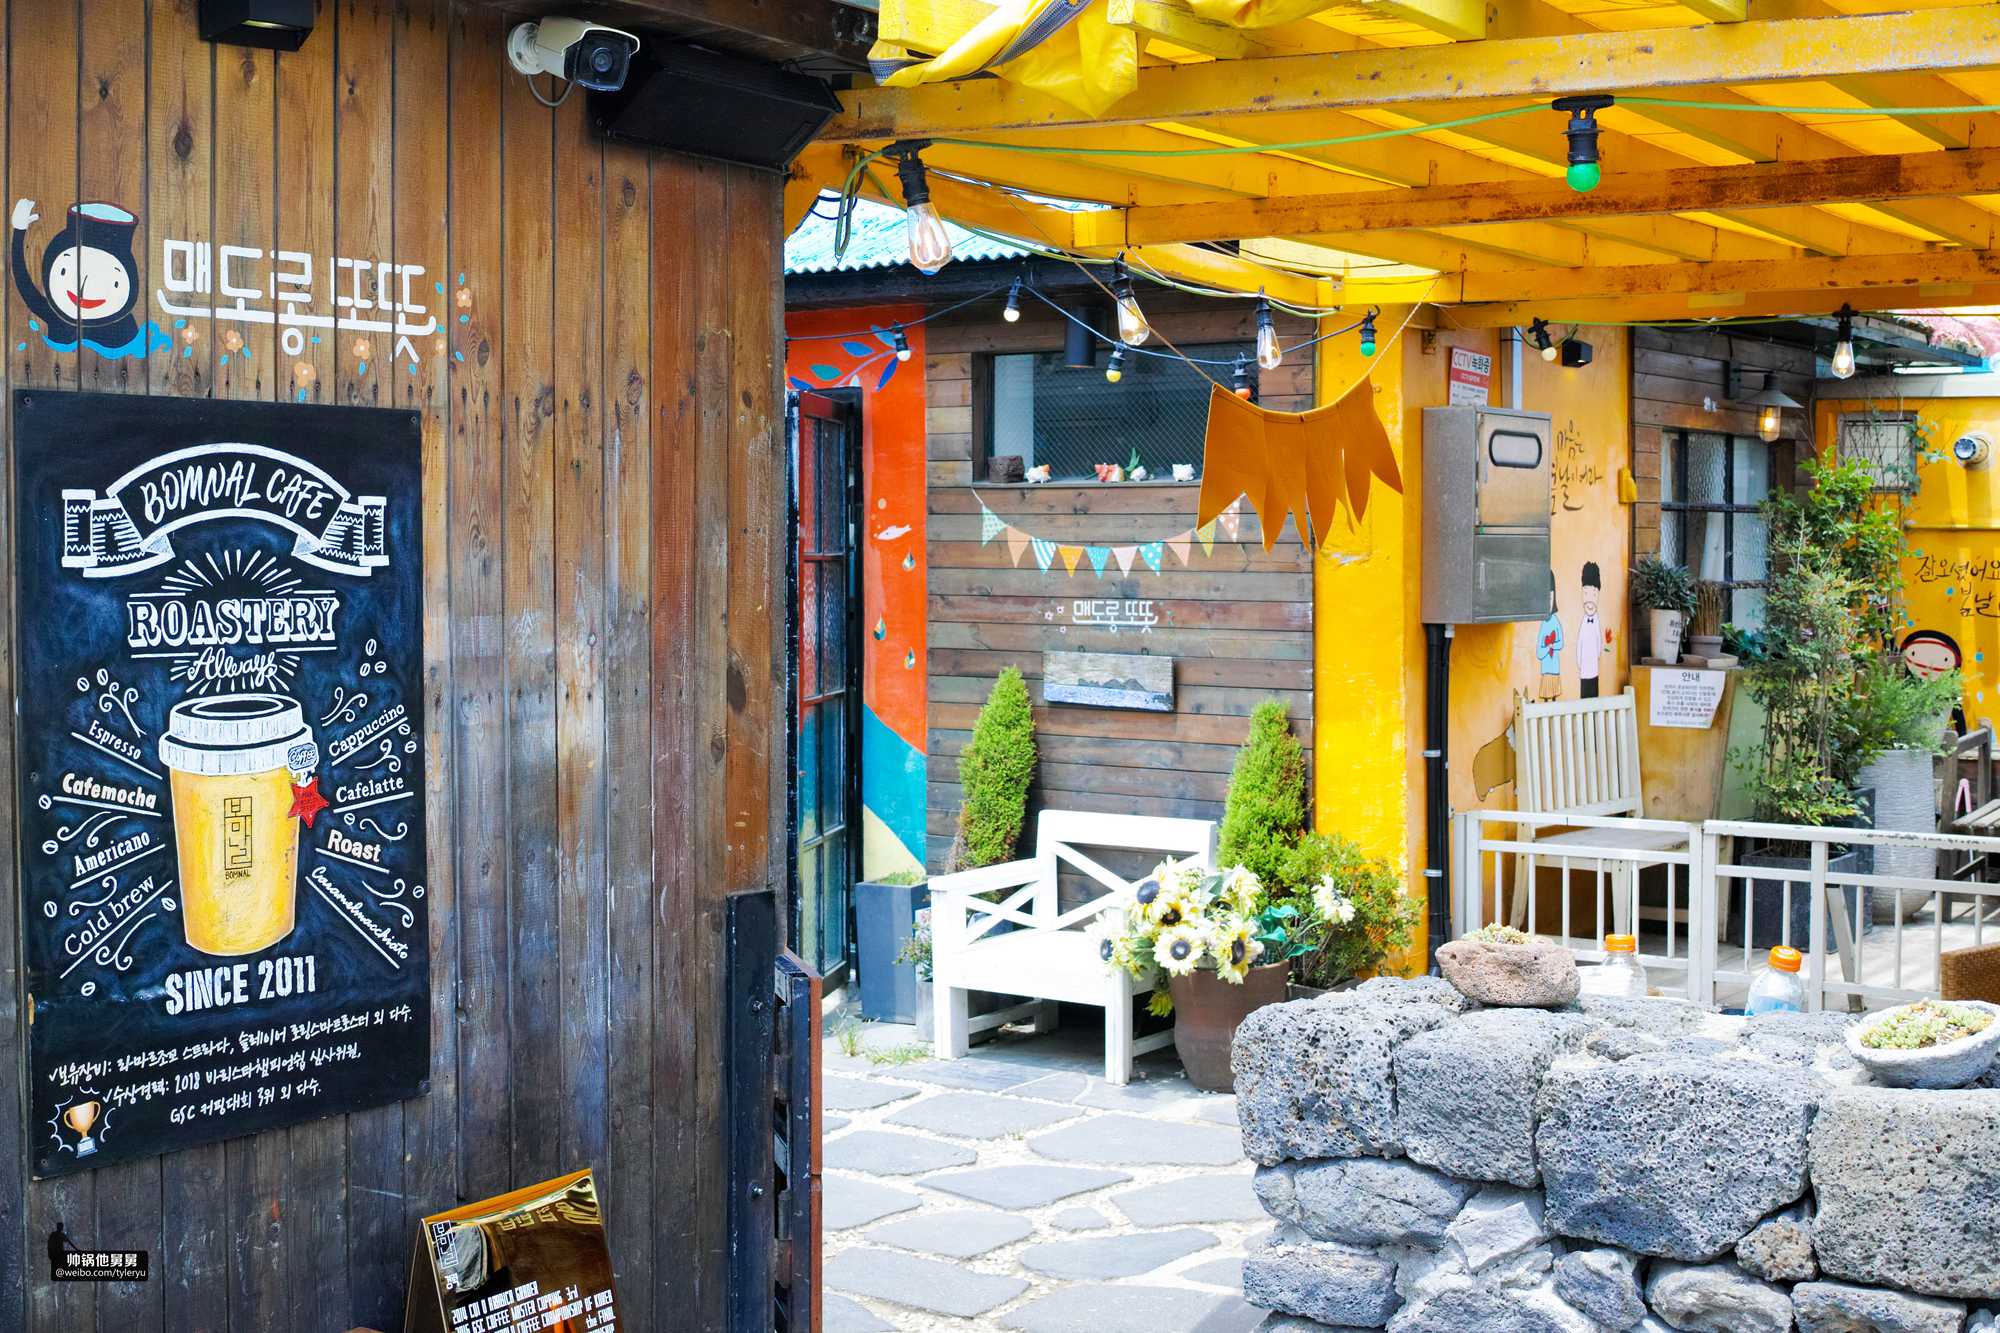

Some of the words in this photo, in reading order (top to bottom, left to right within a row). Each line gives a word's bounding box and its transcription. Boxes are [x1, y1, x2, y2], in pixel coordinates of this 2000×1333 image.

[141, 460, 261, 525] BOMNAL
[266, 468, 335, 519] CAFE
[127, 597, 340, 648] ROASTERY
[187, 646, 279, 688] Always
[1681, 671, 1701, 682] 안내
[88, 719, 142, 760] Espresso
[328, 703, 406, 758] Cappuccino
[62, 772, 157, 810] Cafemocha
[335, 775, 405, 803] Cafelatte
[73, 831, 151, 878] Americano
[327, 829, 382, 863] Roast
[225, 869, 251, 880] BOMNAL
[64, 909, 113, 956] Cold
[107, 875, 155, 919] brew
[311, 866, 409, 960] Caramelmacchiato
[164, 963, 249, 1016] SINCE
[257, 955, 316, 1001] 2011
[175, 1070, 201, 1095] 2018
[170, 1104, 196, 1125] GSC
[486, 1309, 511, 1331] COFFEE
[510, 1299, 537, 1321] MASTER
[565, 1284, 579, 1302] 3rd
[541, 1299, 584, 1328] CHAMPIONSHIP
[583, 1295, 593, 1312] OF
[585, 1313, 598, 1329] the
[597, 1306, 617, 1324] FINAL
